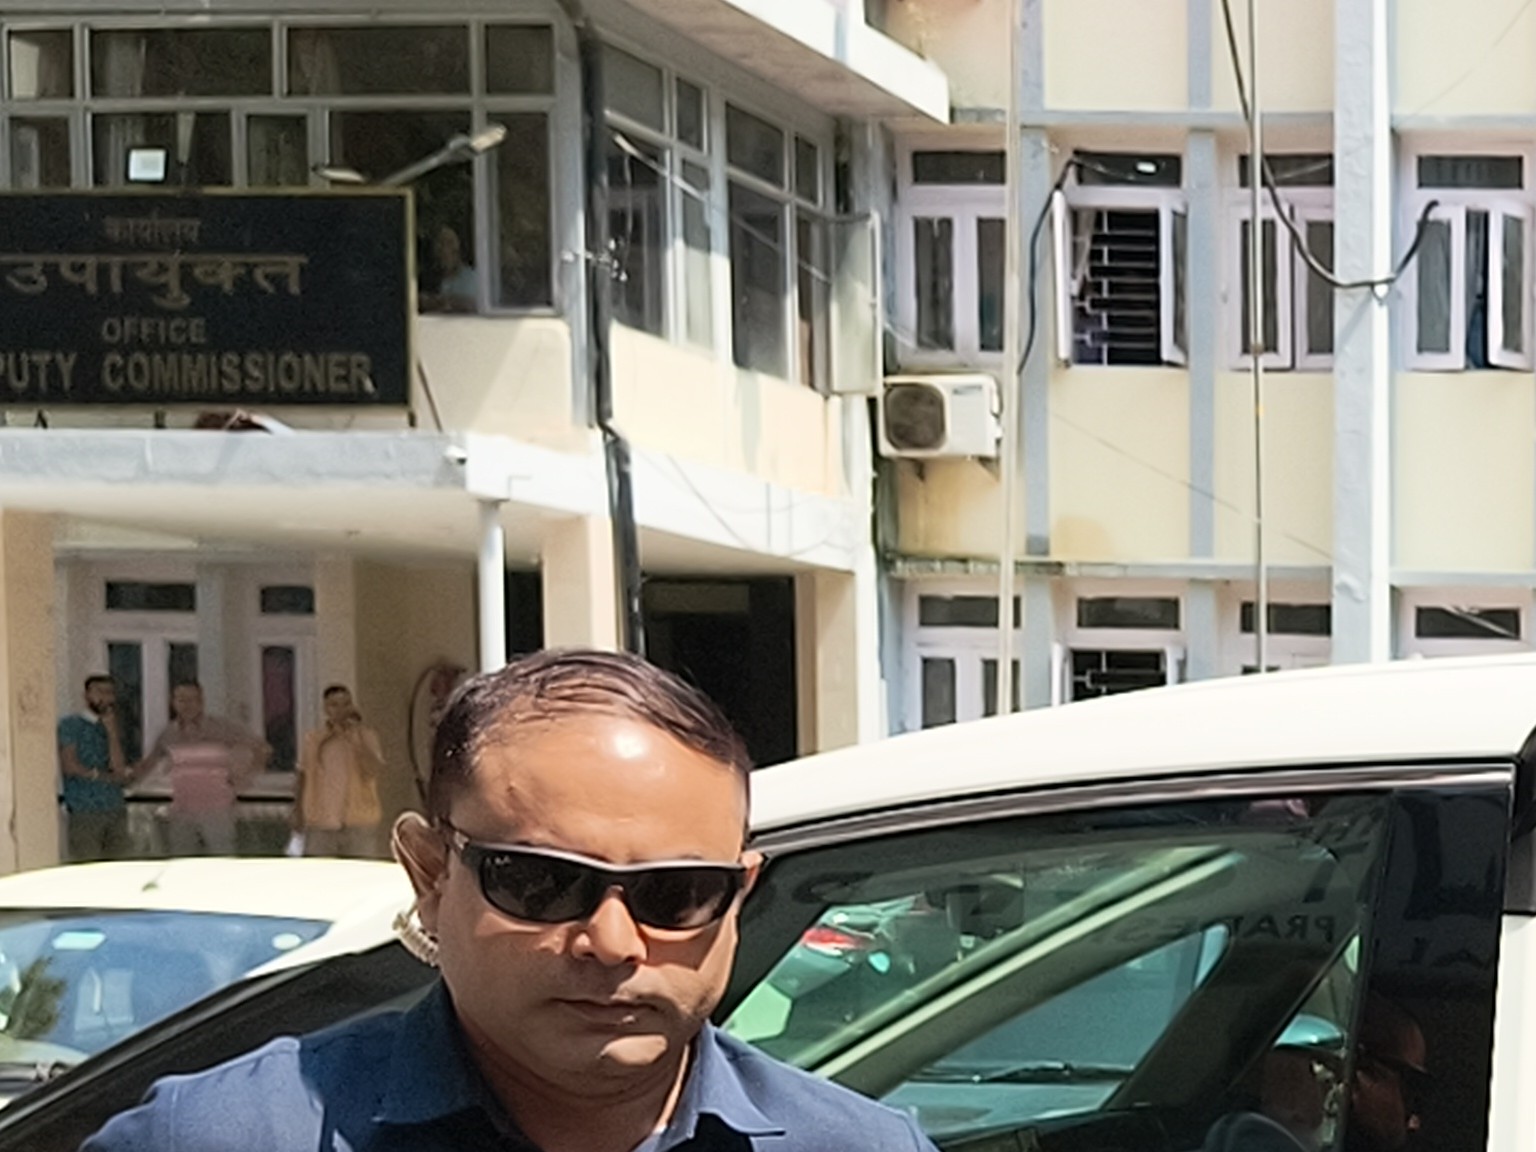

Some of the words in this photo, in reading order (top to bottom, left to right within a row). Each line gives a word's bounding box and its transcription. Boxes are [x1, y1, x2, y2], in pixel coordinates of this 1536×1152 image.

[101, 317, 206, 344] OFFICE
[0, 350, 77, 392] UTY
[101, 350, 376, 393] COMMISSIONER
